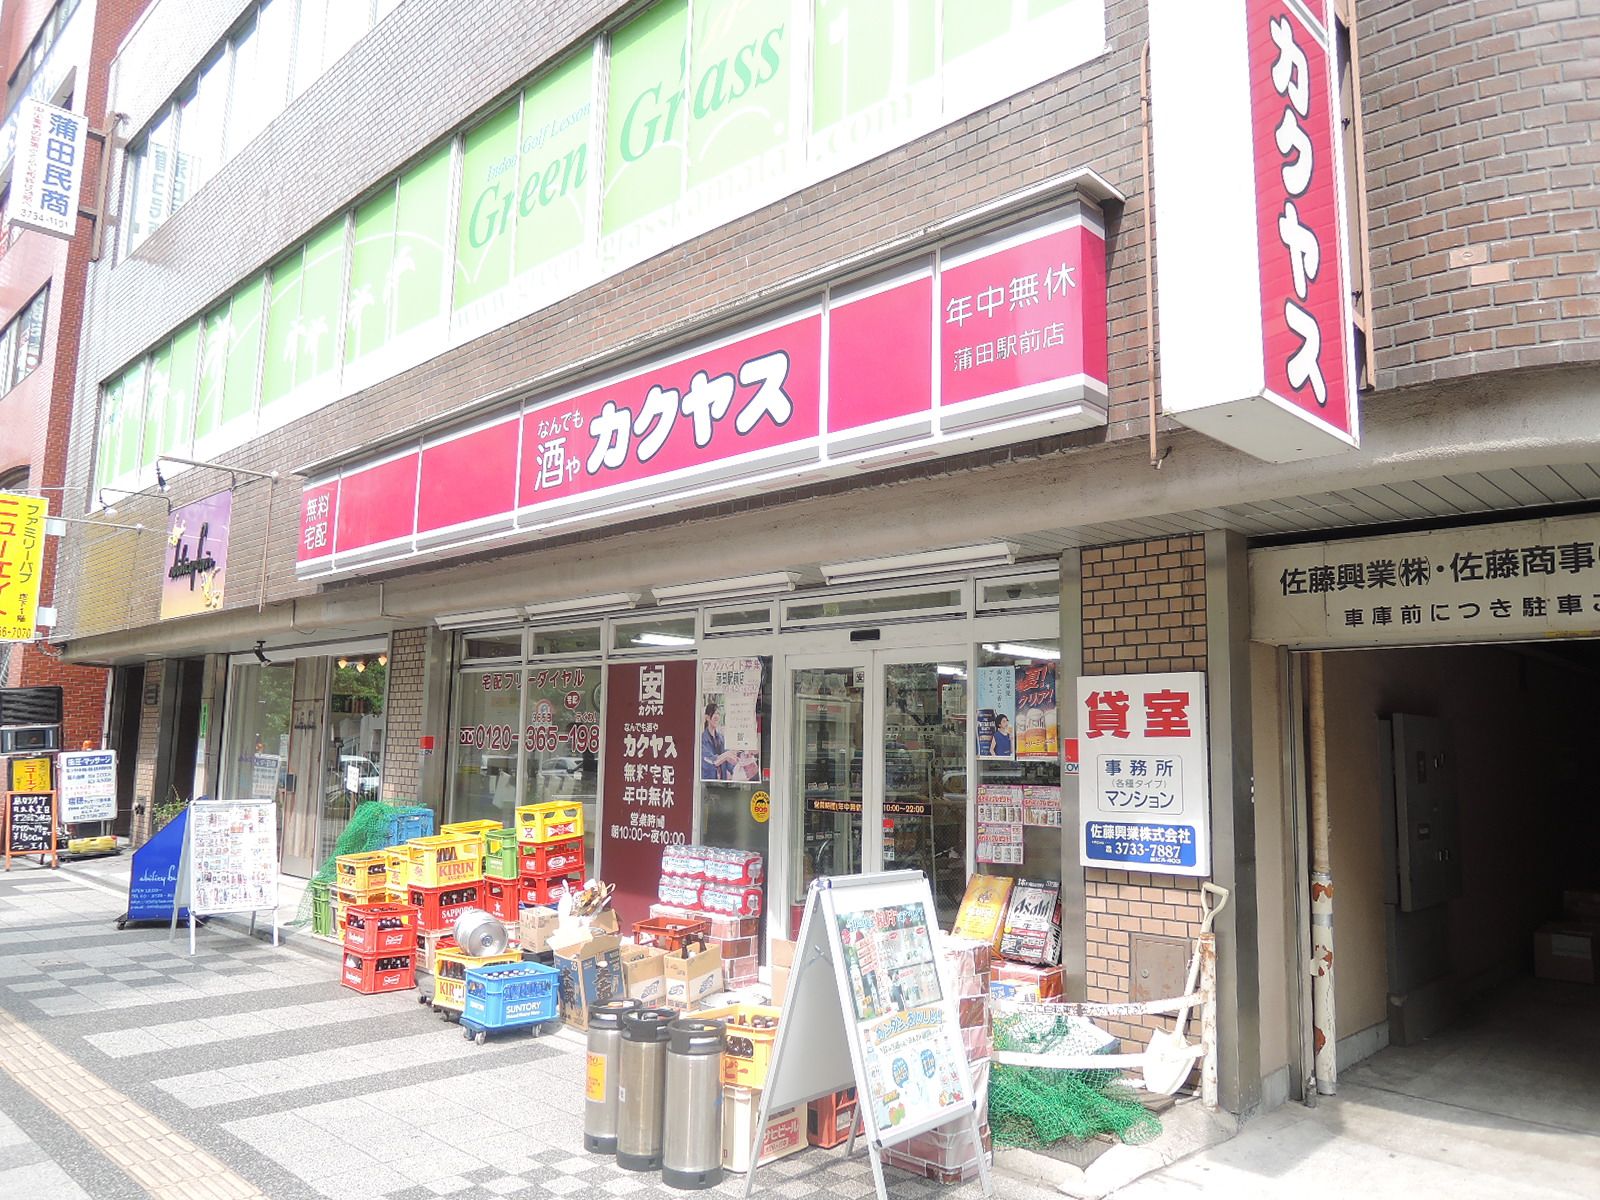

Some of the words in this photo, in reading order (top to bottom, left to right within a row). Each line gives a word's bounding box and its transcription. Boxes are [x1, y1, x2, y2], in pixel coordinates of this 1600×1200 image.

[469, 142, 587, 249] Green
[620, 23, 785, 163] Grass
[40, 112, 79, 217] 蒲田民商
[1268, 14, 1327, 407] カクヤス
[945, 262, 1077, 328] 年中無休
[953, 321, 1066, 373] 蒲田駅前店
[537, 409, 584, 437] なんでも
[586, 349, 794, 476] カクヤス
[534, 437, 582, 491] 酒や
[306, 492, 330, 523] 無料
[19, 504, 39, 584] ファミリーパブ
[304, 521, 328, 550] 宅配
[482, 668, 586, 692] 宅配フリーダイヤル
[638, 704, 664, 716] カクヤス
[1084, 689, 1191, 740] 貸室
[475, 725, 600, 753] 0120-365-198
[623, 734, 678, 759] カクヤス
[623, 762, 675, 785] 無料宅配
[1104, 759, 1173, 778] 事務所
[622, 787, 674, 809] 年中無休
[1105, 790, 1175, 809] マンション
[630, 812, 665, 829] 営業時間
[1090, 823, 1192, 845] 佐藤興業株式会社
[1115, 841, 1181, 858] 3733-7887
[439, 861, 475, 877] KIRIN
[1013, 898, 1050, 919] Asahi
[506, 1001, 541, 1013] SUNTORY
